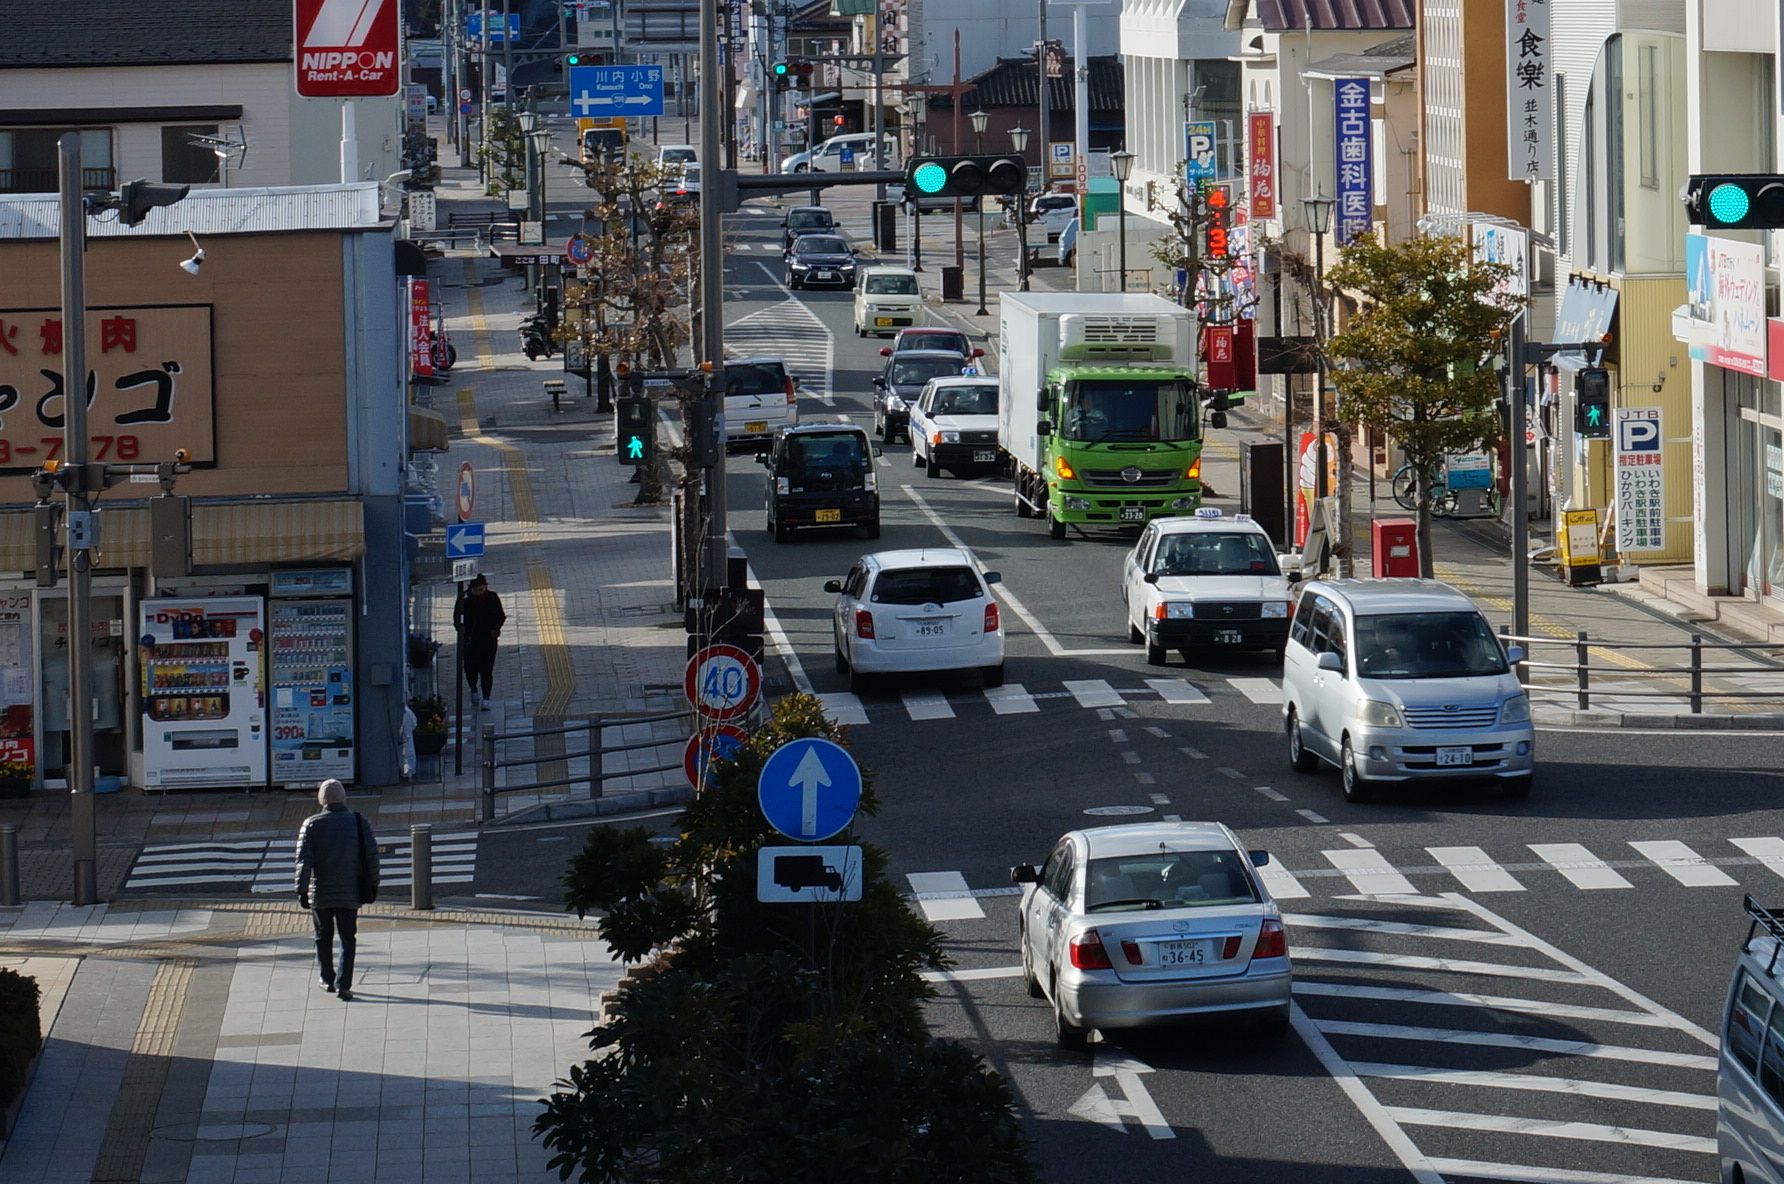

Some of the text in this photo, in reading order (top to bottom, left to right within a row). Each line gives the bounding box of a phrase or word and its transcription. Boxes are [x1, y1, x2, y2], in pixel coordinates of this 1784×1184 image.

[302, 51, 393, 70] NIPPON
[307, 70, 383, 81] Rent-A-Car
[596, 70, 660, 83] 川内 小野
[539, 256, 560, 264] 田町
[1620, 411, 1658, 419] JTB
[1623, 421, 1657, 450] P
[1619, 454, 1661, 466] 指定駐車場
[1620, 470, 1634, 548] ひかりパーキング
[1635, 470, 1648, 547] いわき駅西駐車場
[1648, 470, 1662, 547] いわき駅前駐車場
[921, 625, 943, 635] 89-05
[703, 666, 742, 699] 40
[1169, 950, 1204, 963] 36-45
